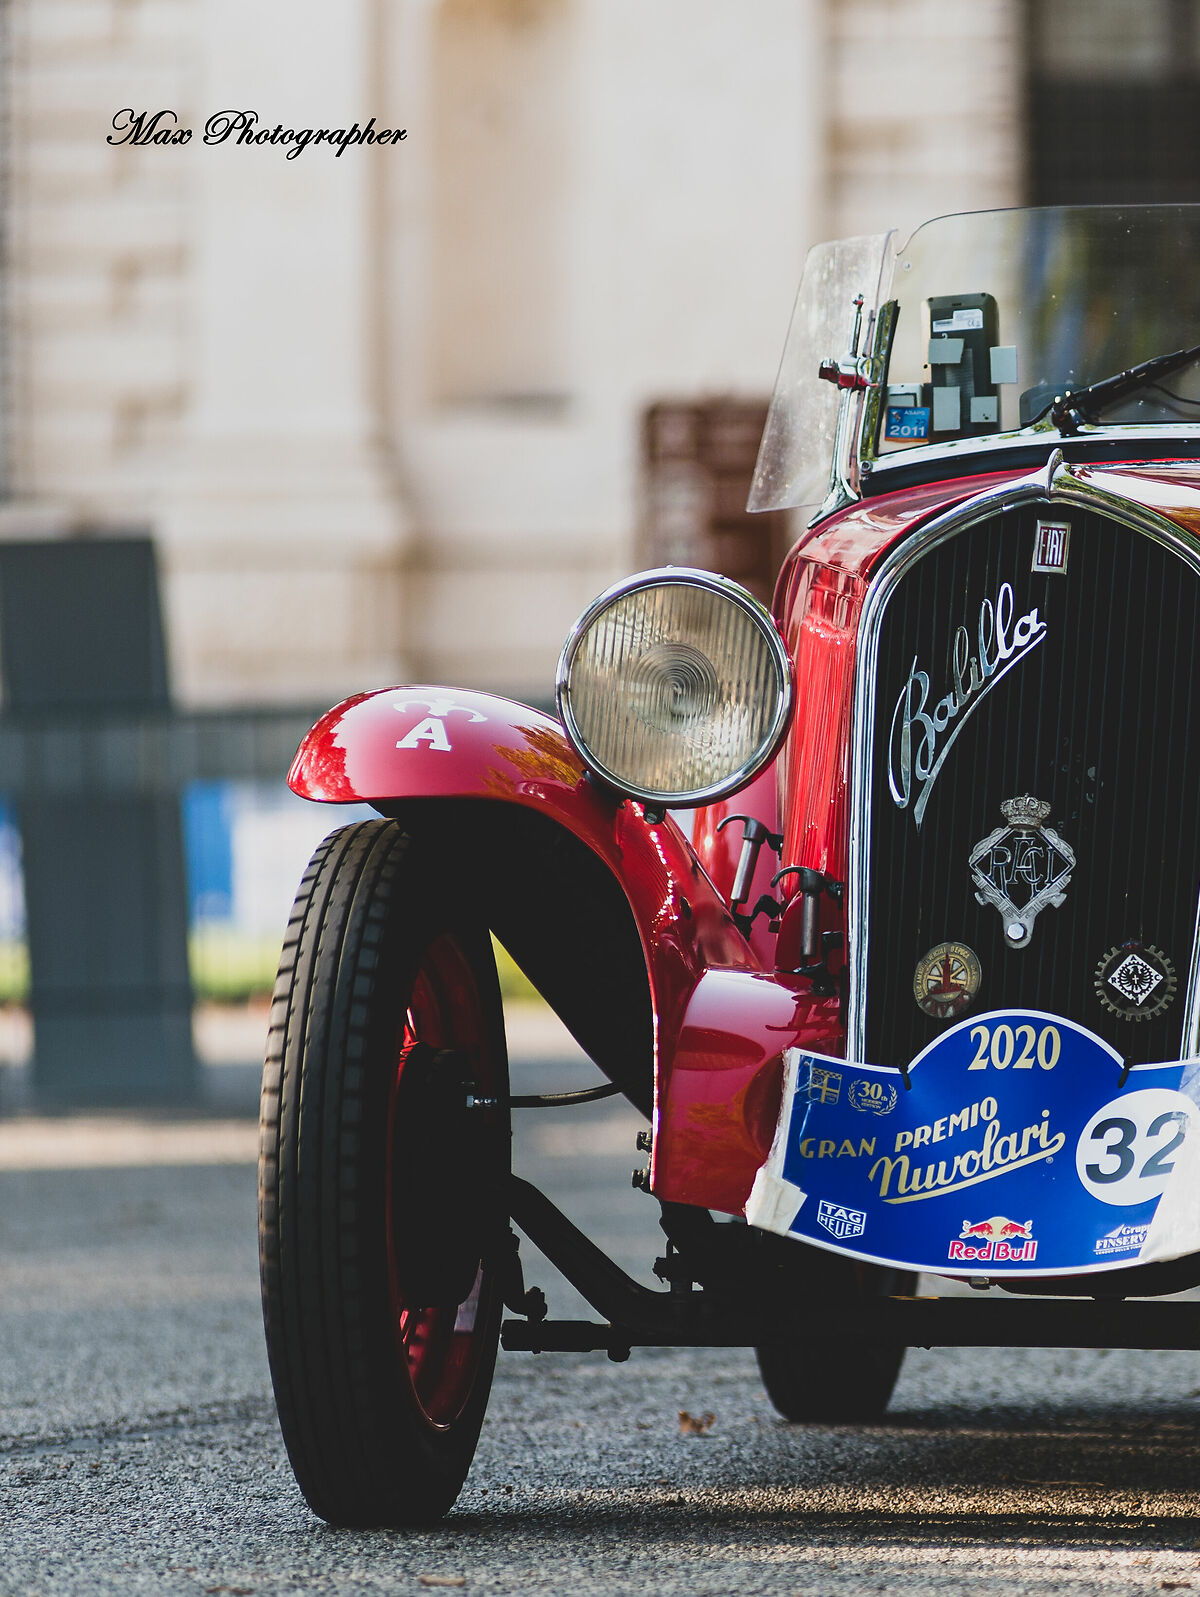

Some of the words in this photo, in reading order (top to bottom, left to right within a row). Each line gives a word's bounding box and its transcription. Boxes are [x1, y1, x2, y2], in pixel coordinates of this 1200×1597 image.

[890, 425, 925, 437] 2011
[1038, 529, 1066, 565] FIAT
[887, 582, 1047, 831] Balilla
[395, 717, 452, 752] A
[967, 1025, 1061, 1071] 2020
[800, 1137, 876, 1159] GRAN
[895, 1097, 998, 1153] PREMIO
[1085, 1111, 1187, 1185] 32
[820, 1215, 861, 1236] HEUER
[823, 1203, 861, 1224] TAG
[1095, 1233, 1147, 1249] FINSERV
[1121, 1226, 1148, 1236] Grup
[948, 1240, 991, 1260] Red
[993, 1240, 1038, 1261] Bull
